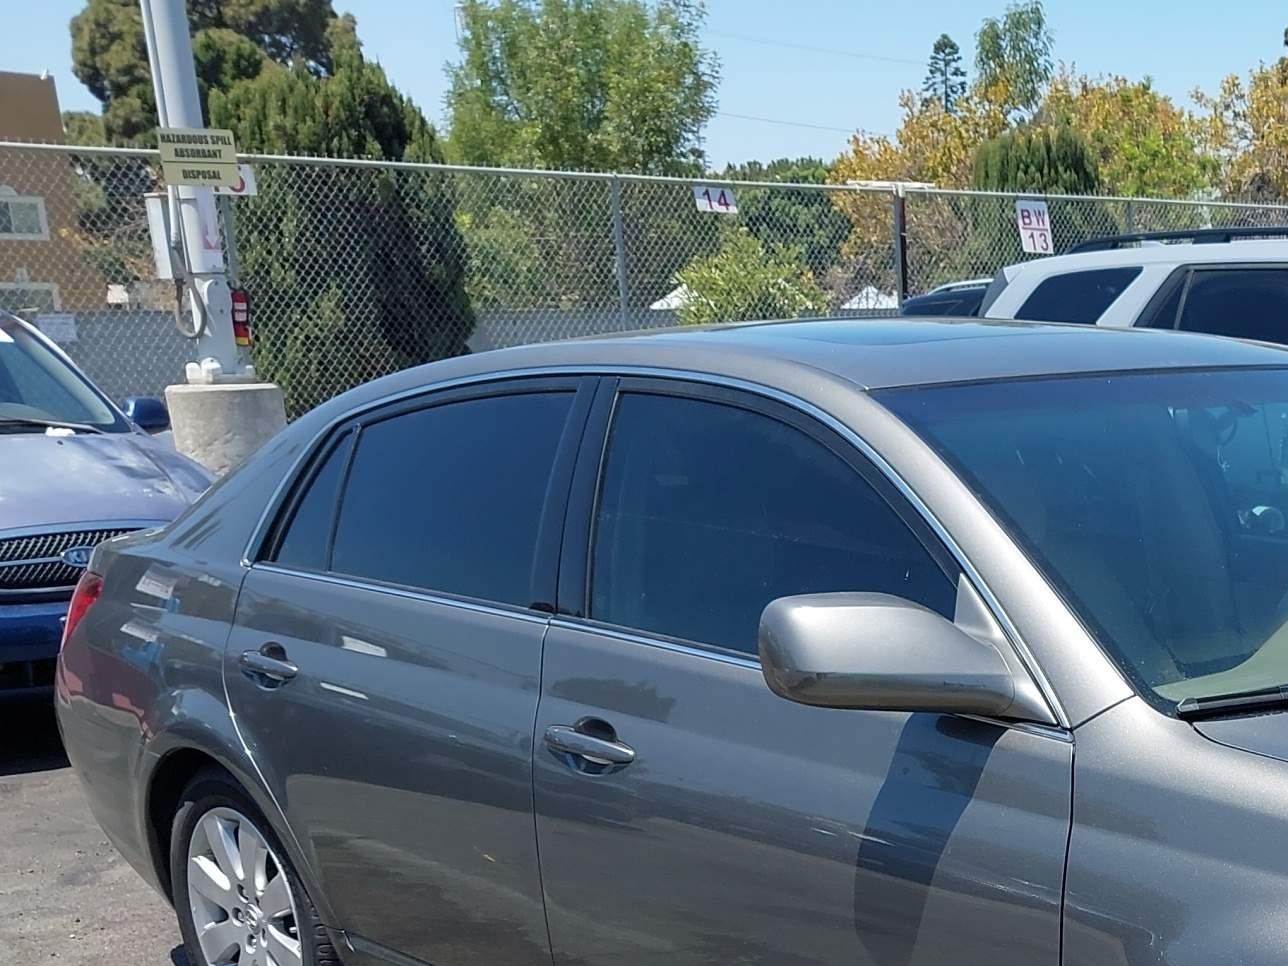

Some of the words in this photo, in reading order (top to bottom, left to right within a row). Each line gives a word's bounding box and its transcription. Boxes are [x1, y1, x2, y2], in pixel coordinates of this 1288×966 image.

[160, 133, 208, 145] HAZARDOUS
[210, 135, 232, 146] SPILL
[182, 168, 222, 180] DISPOSAL
[702, 189, 730, 210] 14
[1028, 231, 1049, 251] 13
